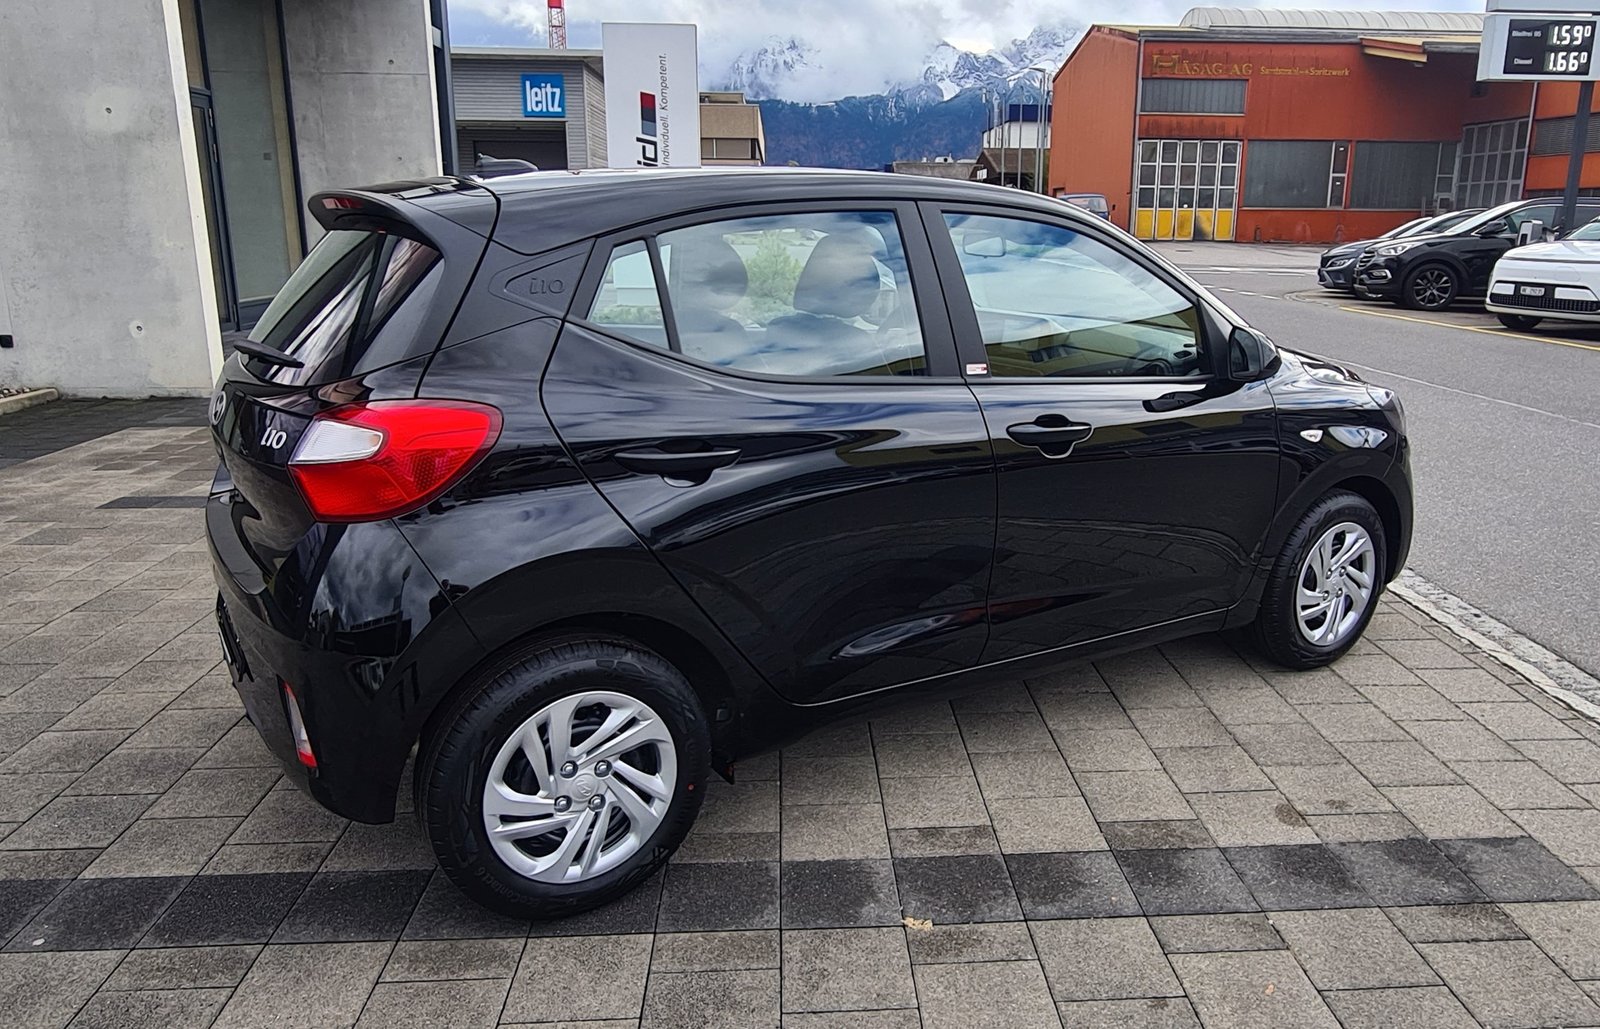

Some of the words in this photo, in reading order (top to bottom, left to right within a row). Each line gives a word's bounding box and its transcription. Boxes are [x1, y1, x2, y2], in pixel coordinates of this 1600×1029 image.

[1229, 63, 1253, 76] AG
[658, 52, 669, 112] Kompetent.
[525, 80, 563, 113] leitz
[529, 277, 566, 295] i10
[260, 426, 288, 450] i10
